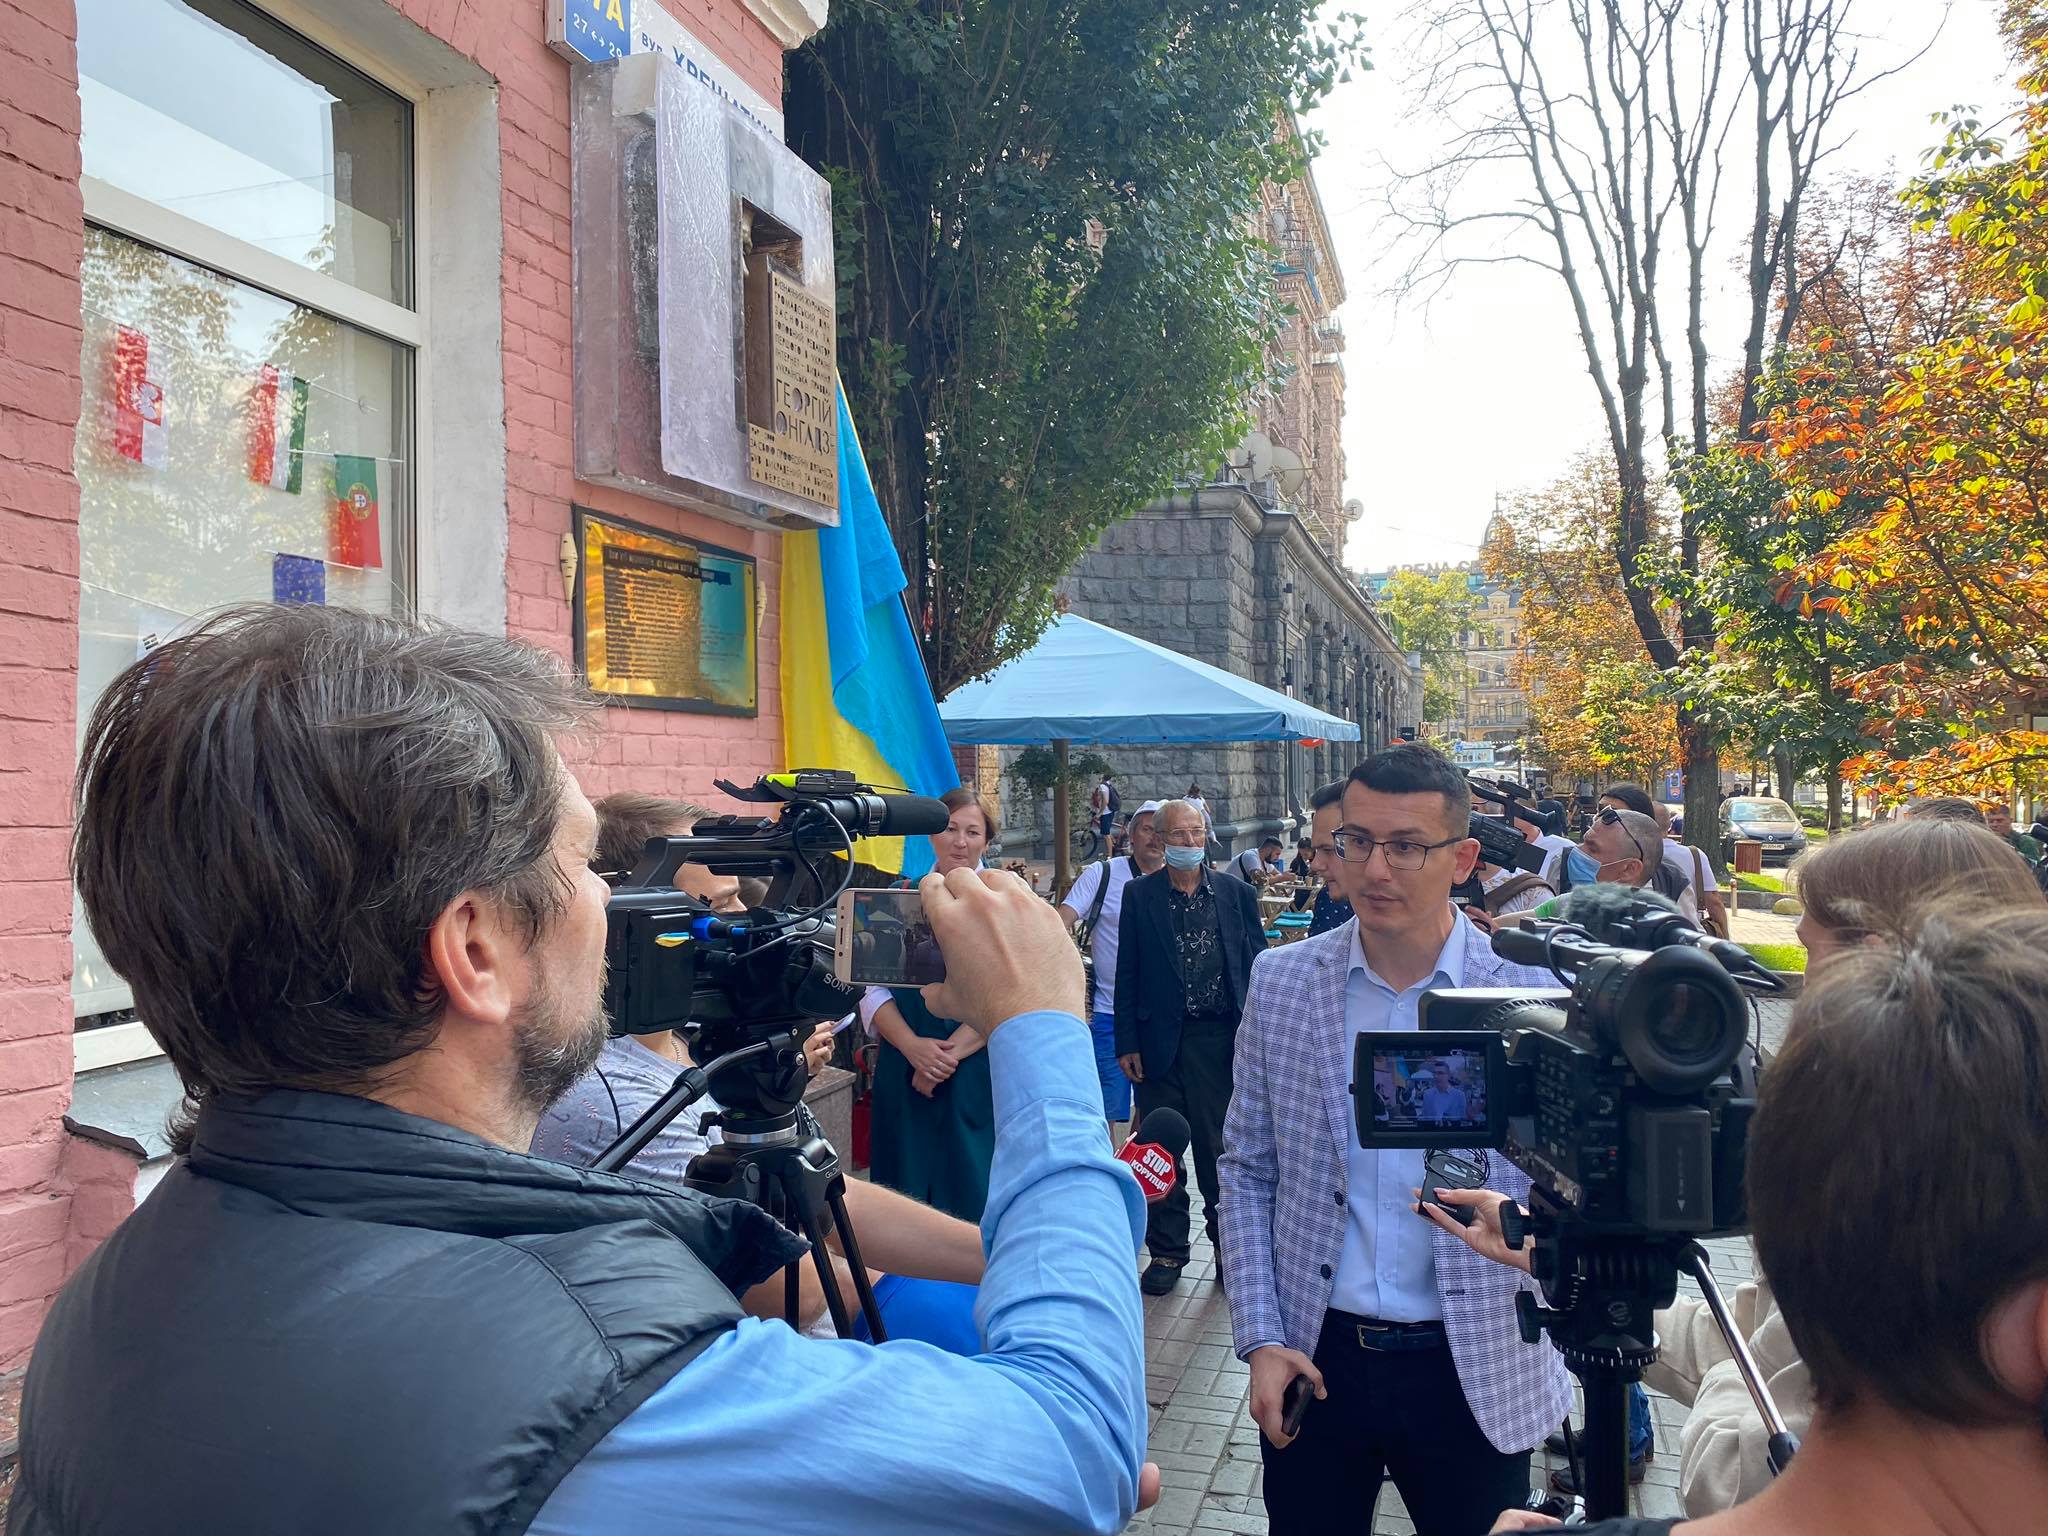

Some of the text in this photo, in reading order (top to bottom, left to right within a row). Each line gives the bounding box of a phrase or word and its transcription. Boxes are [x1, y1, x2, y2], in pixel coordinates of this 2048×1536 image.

[573, 13, 588, 34] 27
[776, 378, 832, 427] ГЕОРГІЙ
[823, 972, 855, 995] SONY
[1142, 1148, 1172, 1176] STOP
